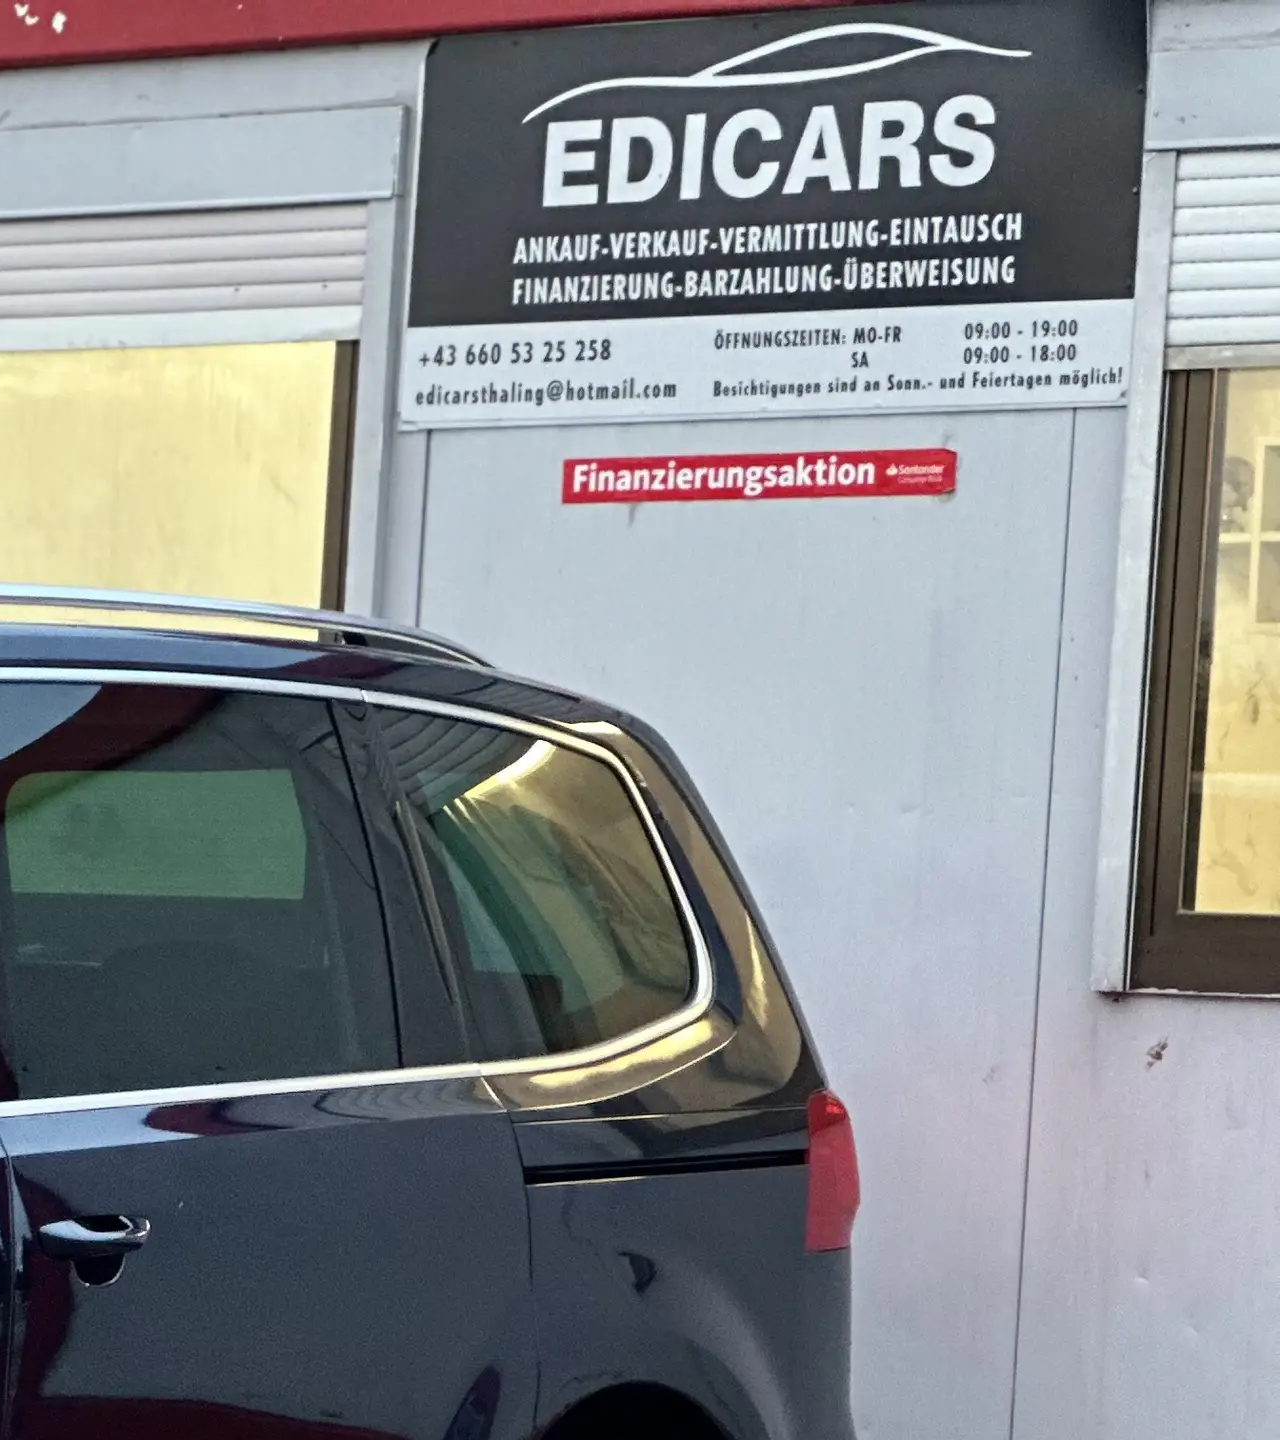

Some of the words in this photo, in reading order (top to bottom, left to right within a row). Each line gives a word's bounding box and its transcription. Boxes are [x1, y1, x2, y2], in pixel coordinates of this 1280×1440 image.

[542, 95, 996, 207] EDICARS
[513, 213, 1023, 264] ANKAUF-VERKAUF-VERMITTLUNG-EINTAUSCH
[513, 256, 1016, 304] FINANZIERUNG-BARZAHLUNG-ÜBERWEISUNG
[714, 328, 846, 350] ÖFFNUNGSZEITEN:
[852, 326, 902, 345] MO-FR
[964, 322, 1011, 340] 09:00
[1031, 319, 1078, 338] 19:00
[418, 344, 457, 367] +43
[465, 343, 501, 365] 660
[510, 342, 533, 364] 53
[543, 340, 566, 363] 25
[575, 339, 612, 361] 258
[851, 351, 869, 368] SA
[963, 346, 1010, 364] 09:00
[1030, 343, 1077, 362] 18:00
[415, 377, 677, 406] edicarsthaling@hotmail.com
[713, 380, 821, 398] Besichtigungen
[827, 375, 857, 393] sind
[864, 378, 880, 392] an
[940, 371, 965, 389] und
[972, 367, 1052, 390] Feiertagen
[1059, 366, 1123, 388] möglich!
[573, 456, 875, 496] Finanzierungsaktion
